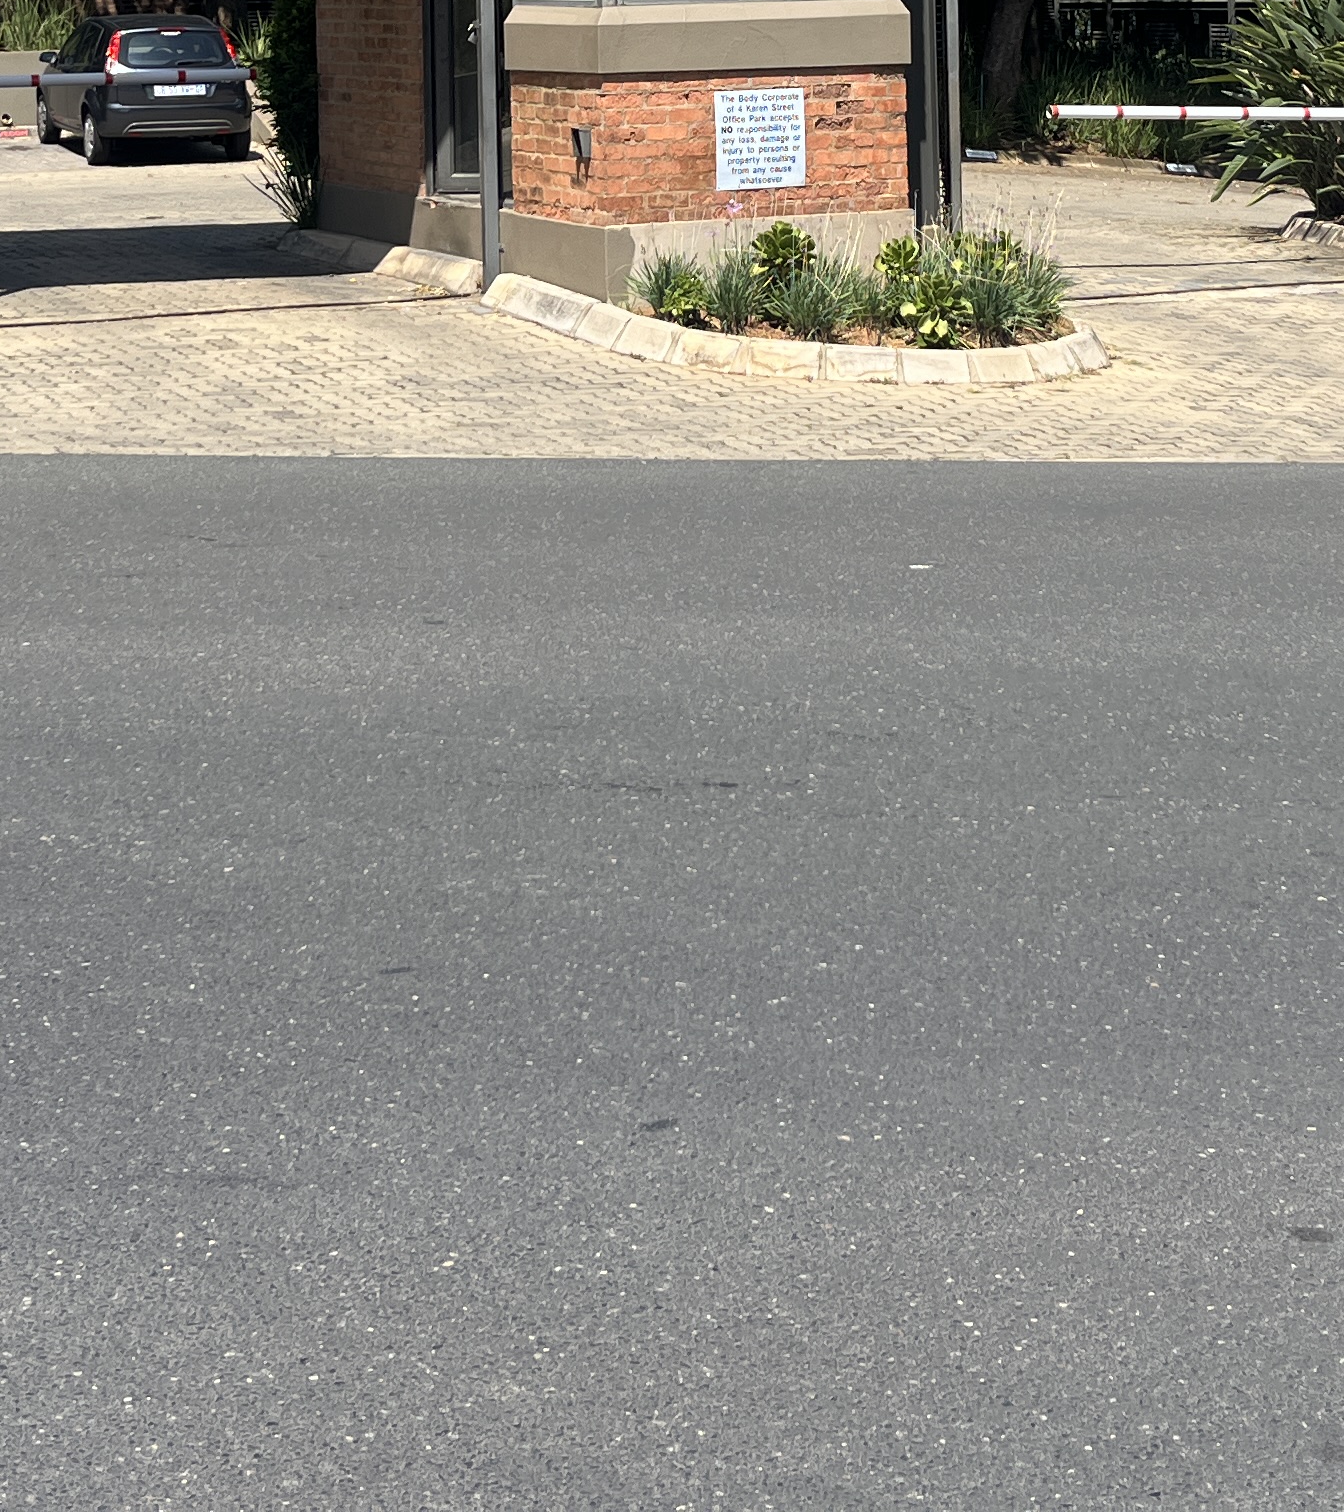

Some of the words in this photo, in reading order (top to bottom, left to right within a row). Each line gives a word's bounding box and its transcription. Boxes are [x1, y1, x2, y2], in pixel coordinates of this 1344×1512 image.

[739, 94, 758, 103] Body
[762, 94, 799, 102] Corporate
[770, 114, 799, 122] accepts
[721, 126, 733, 134] NO
[737, 125, 786, 134] responsibility
[760, 135, 789, 143] damage
[723, 147, 743, 156] injury
[759, 146, 788, 154] persons
[728, 157, 760, 166] property
[764, 154, 796, 163] resulting
[753, 167, 766, 175] any
